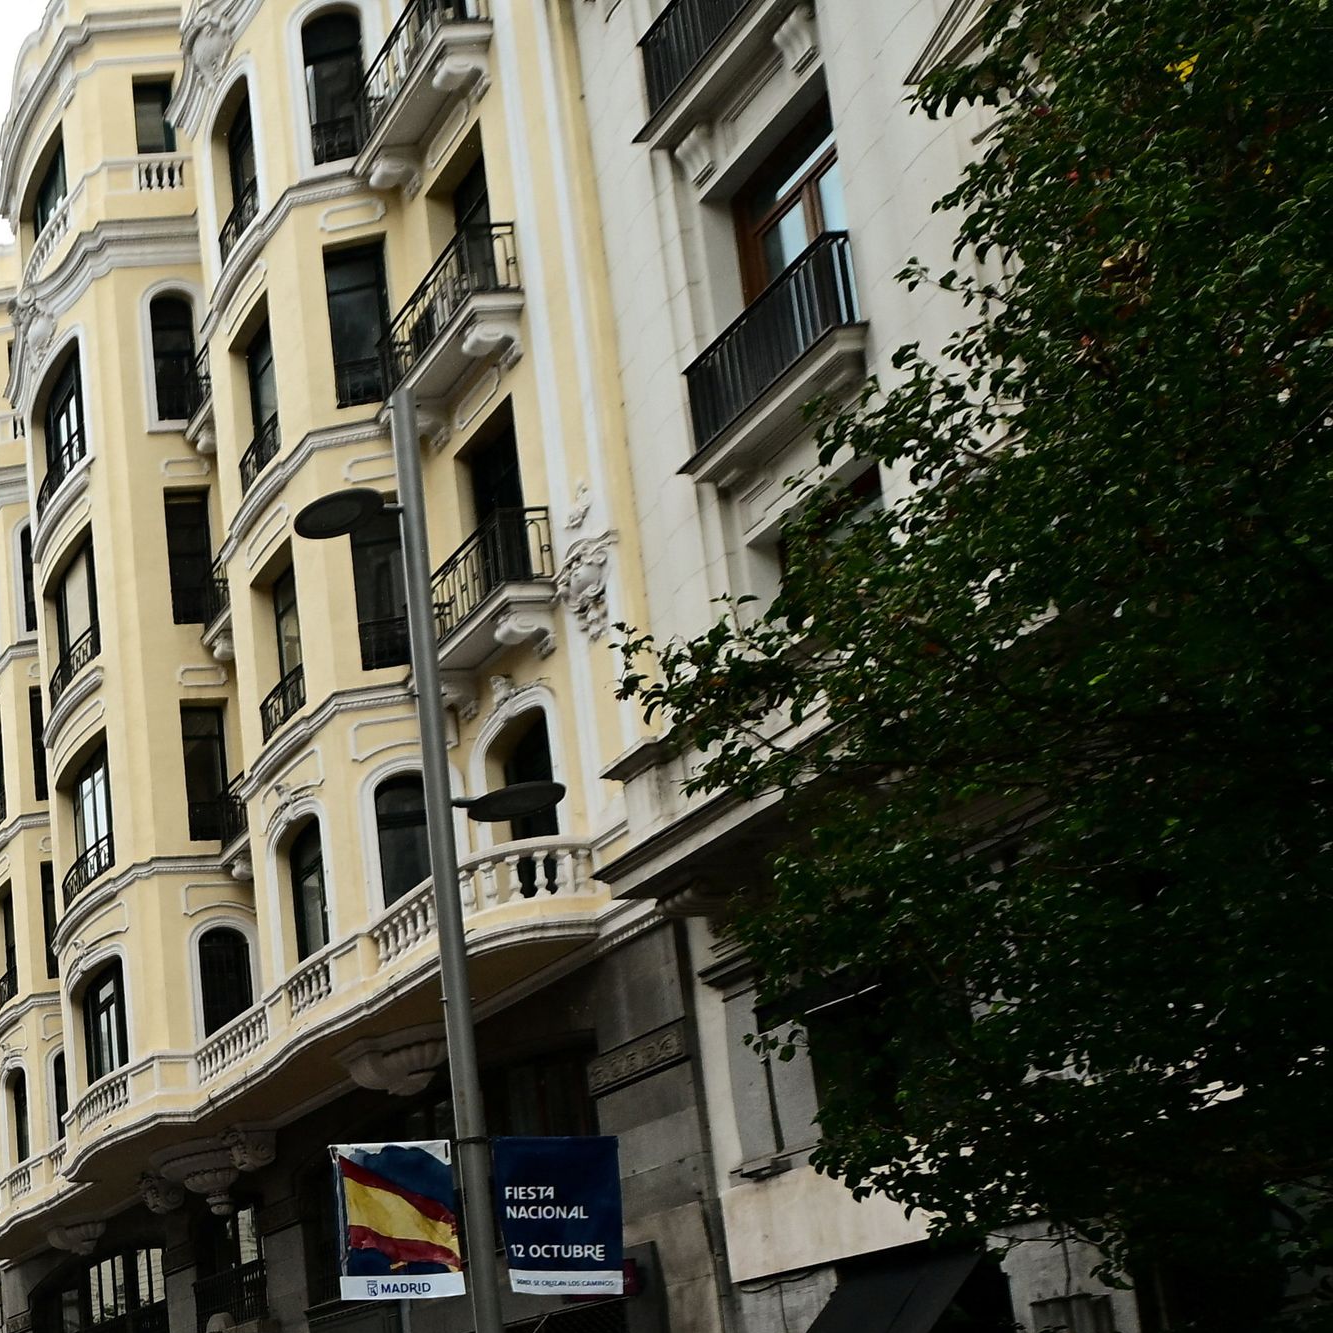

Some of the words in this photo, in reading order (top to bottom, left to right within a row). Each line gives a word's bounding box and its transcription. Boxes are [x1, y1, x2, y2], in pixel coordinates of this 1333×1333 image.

[504, 1186, 554, 1200] FIESTA
[506, 1205, 589, 1220] NACIONAL
[510, 1244, 525, 1257] 12
[529, 1244, 605, 1261] OCTUBRE
[381, 1281, 431, 1296] MADRID
